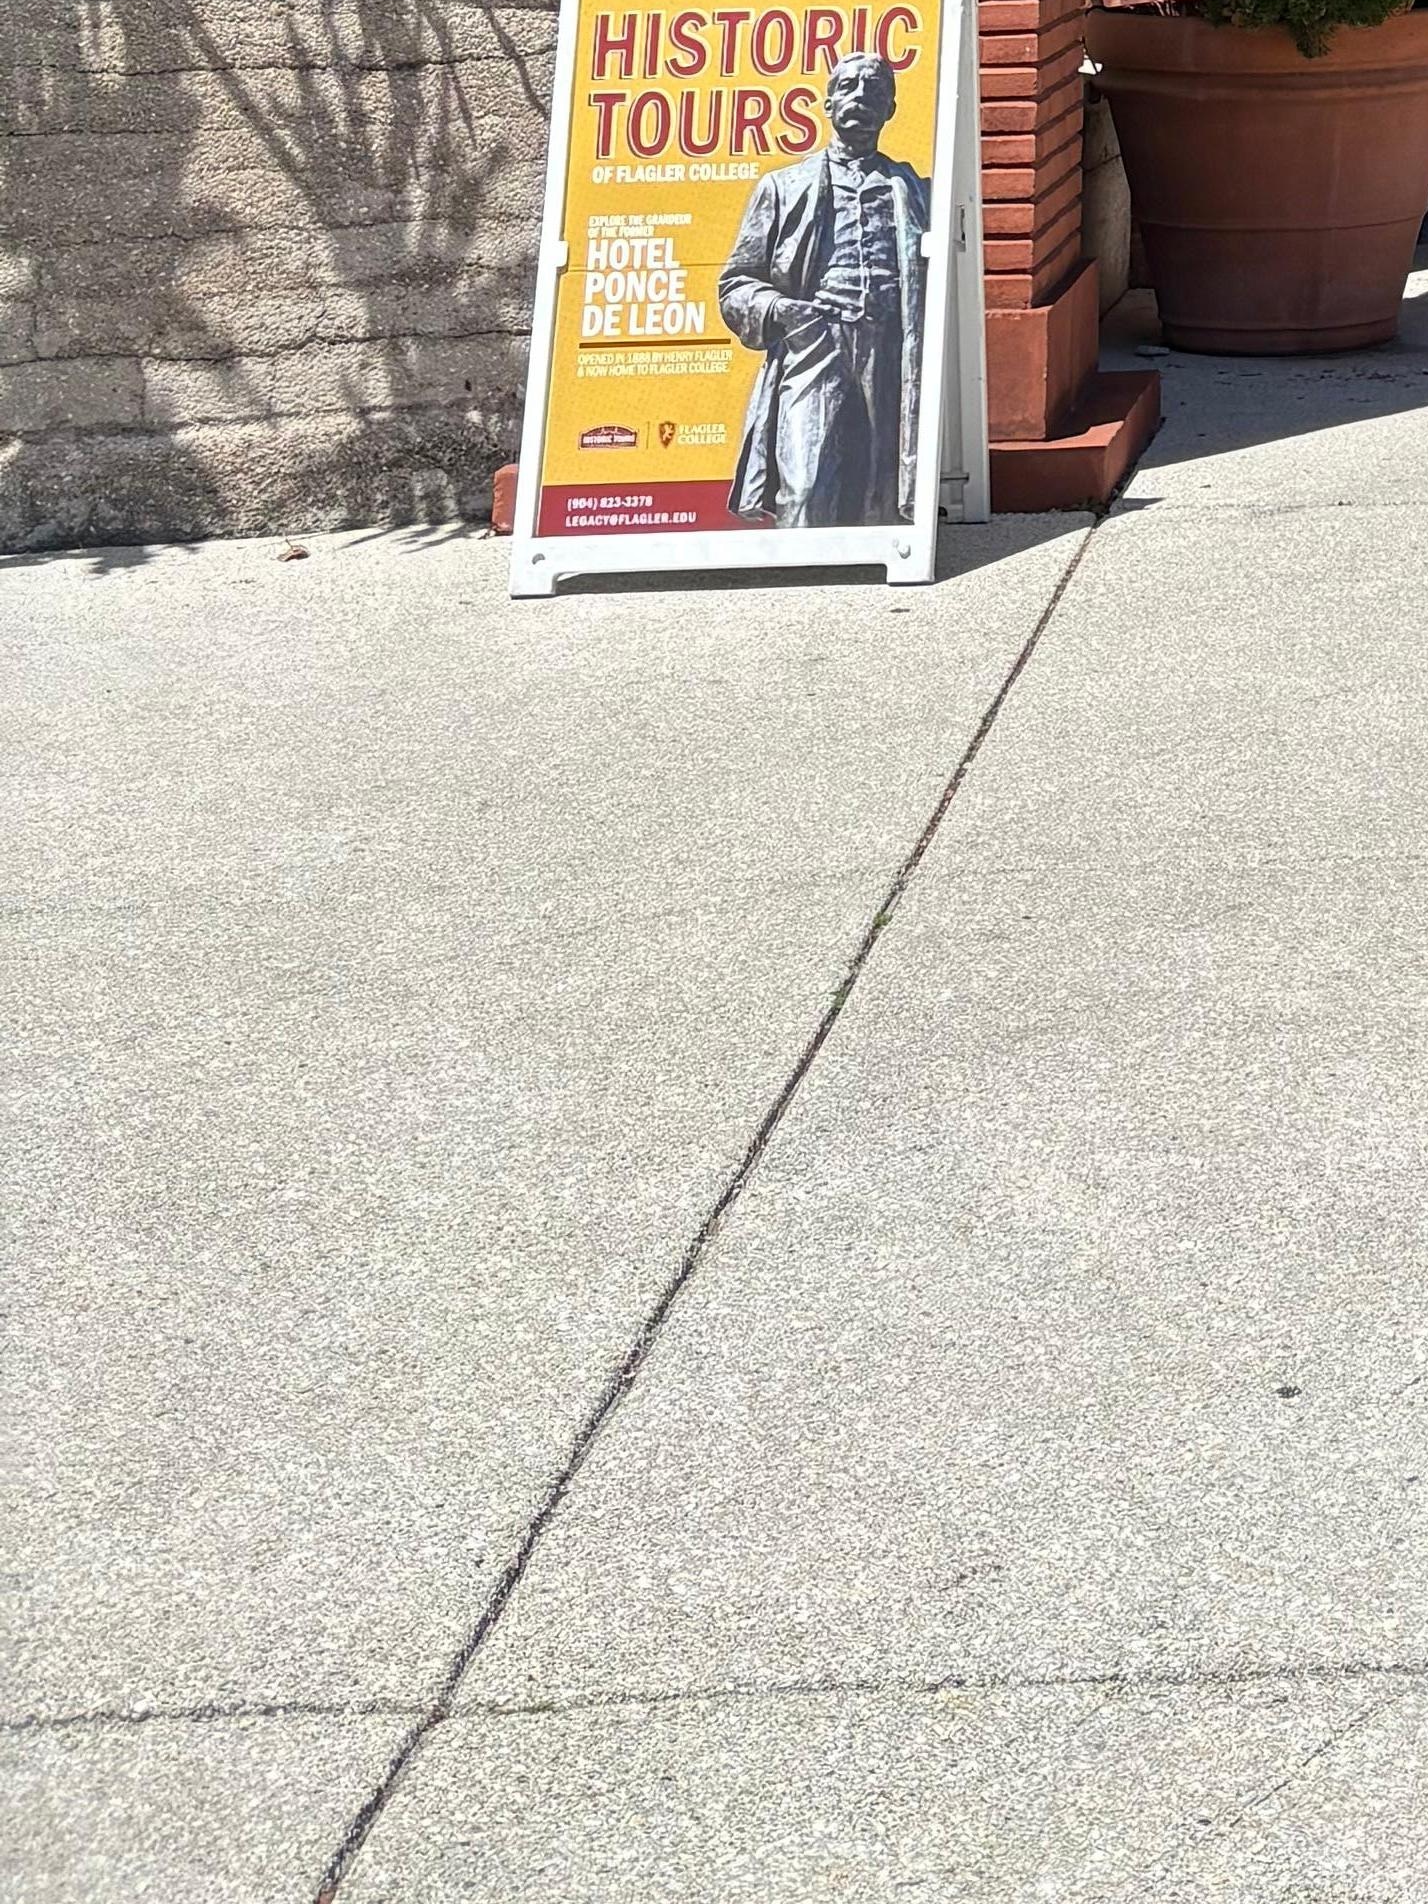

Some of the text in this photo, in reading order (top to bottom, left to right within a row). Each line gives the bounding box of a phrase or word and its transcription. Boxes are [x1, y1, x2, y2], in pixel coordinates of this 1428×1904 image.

[592, 5, 922, 80] HISTORIC
[589, 87, 822, 160] TOURS
[592, 162, 760, 184] OF FLAGLER COLLEGE
[588, 213, 693, 227] EXPLORE THE GRANDEUR
[588, 227, 600, 238] OF
[601, 226, 618, 238] THE
[587, 237, 680, 271] HOTEL
[584, 269, 688, 304] PONCE
[581, 300, 706, 337] DE LEON
[577, 353, 614, 365] OPENED
[615, 352, 625, 364] IN
[652, 351, 663, 363] BY
[664, 350, 694, 363] HENRY
[694, 349, 733, 362] FLAGLER
[577, 365, 584, 377] &
[585, 364, 608, 377] NOW
[609, 363, 635, 376] HOME
[635, 363, 648, 375] TO
[648, 362, 687, 375] FLAGLER
[678, 423, 726, 434] FLAGLER
[677, 434, 726, 445] COLLEGE
[567, 497, 597, 512] (904)
[565, 511, 697, 527] LEGACY@FLAGLER.EDU
